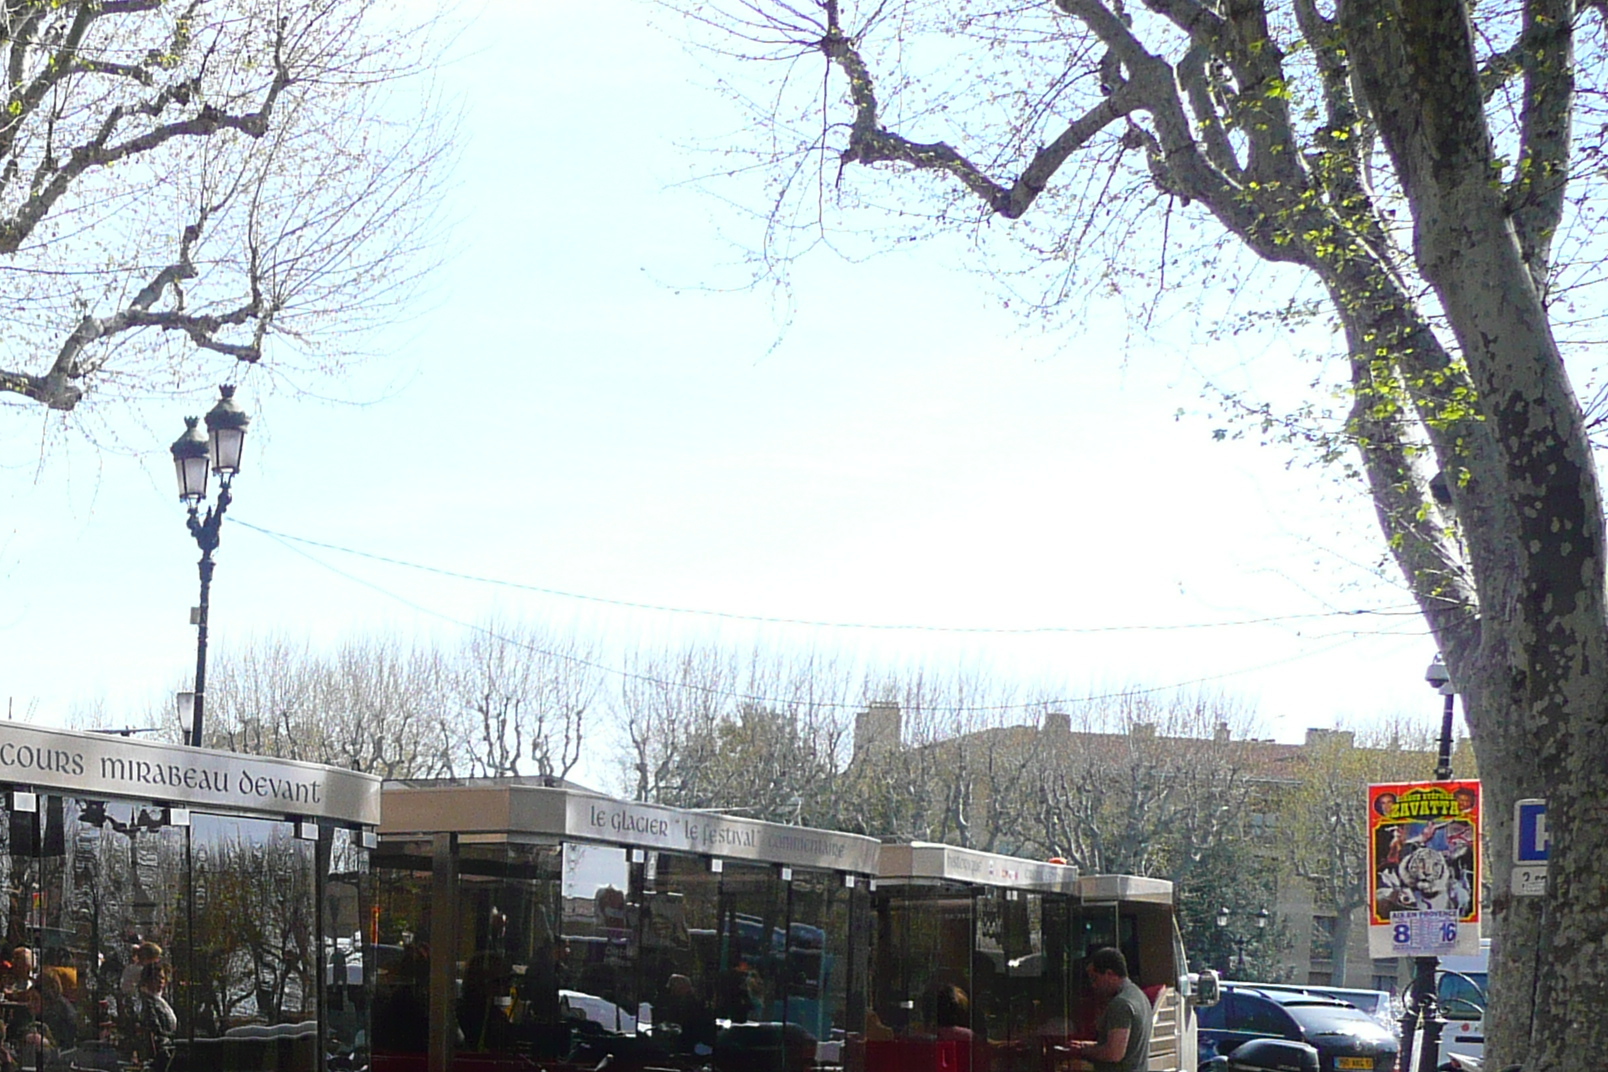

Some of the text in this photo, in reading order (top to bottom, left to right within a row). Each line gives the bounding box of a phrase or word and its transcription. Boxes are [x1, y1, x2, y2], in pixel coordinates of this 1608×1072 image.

[0, 742, 85, 776] cours
[1390, 801, 1459, 818] ZAVATTA
[1393, 924, 1411, 943] 8
[1439, 922, 1456, 942] 16
